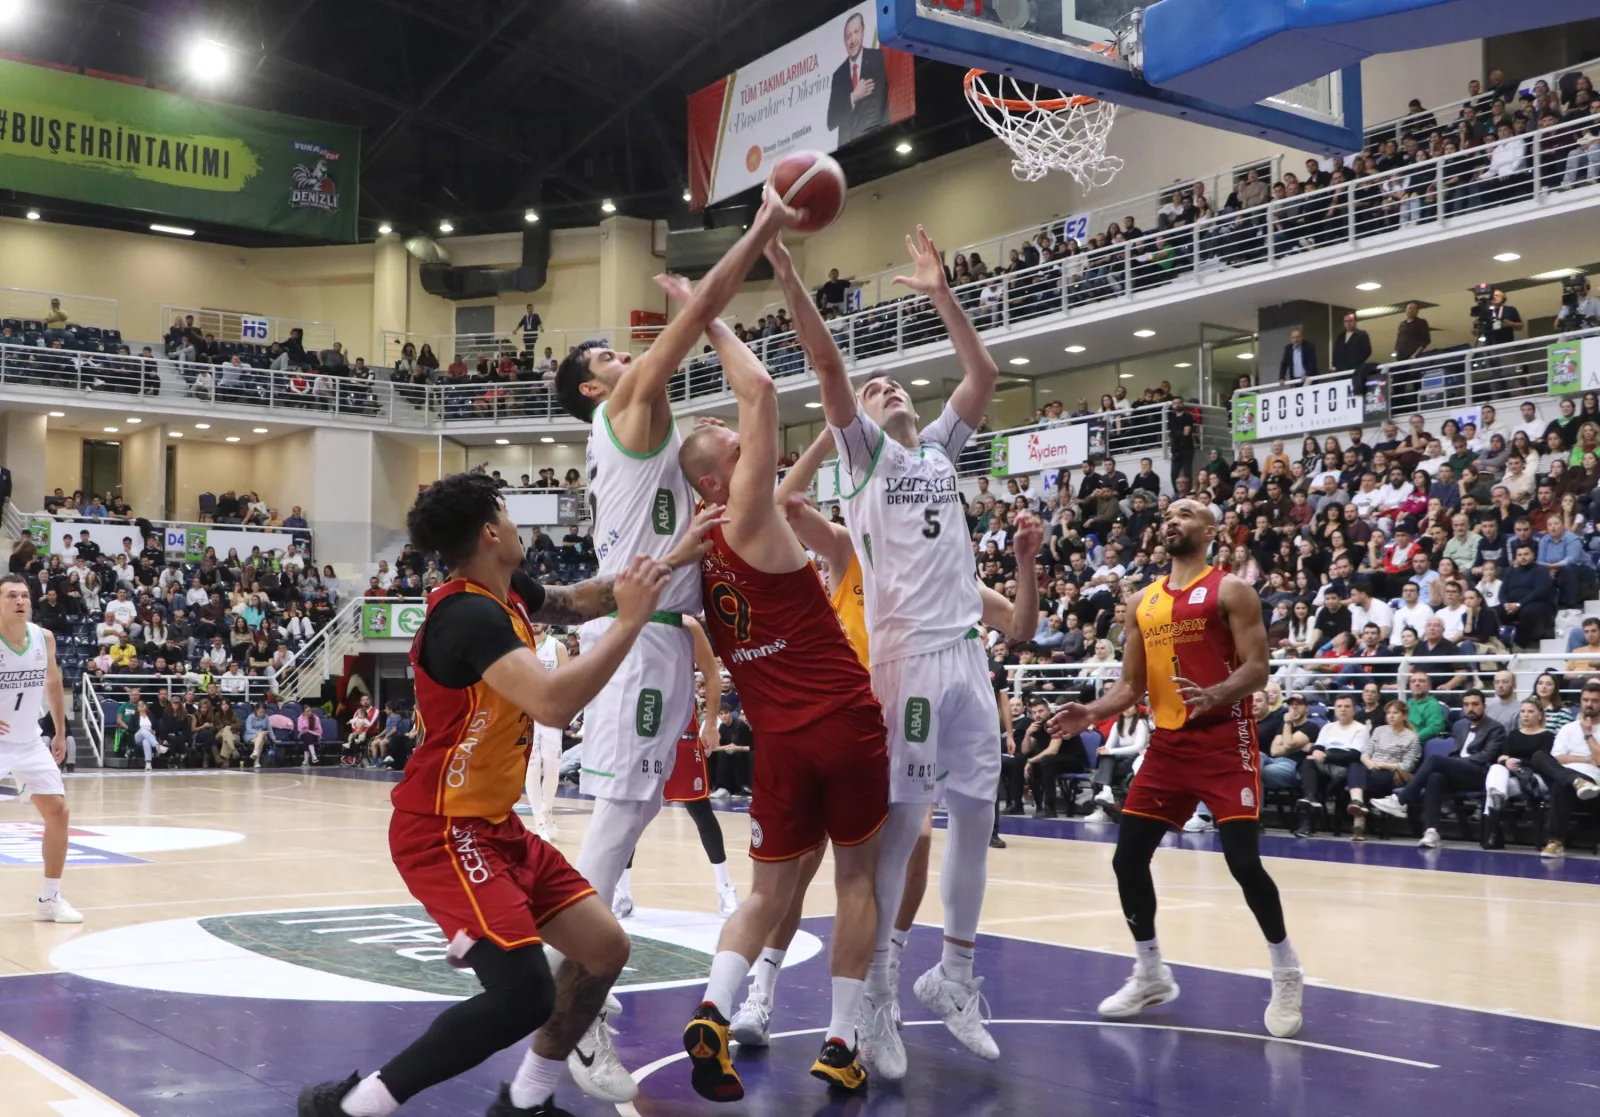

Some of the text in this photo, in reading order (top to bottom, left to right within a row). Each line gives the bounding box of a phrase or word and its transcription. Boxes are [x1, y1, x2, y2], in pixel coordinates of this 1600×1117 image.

[741, 54, 819, 106] TÜM TAKIMLARIMIZA
[0, 108, 230, 180] #BUŞEHRİNTAKIMI
[1067, 217, 1087, 243] E2
[847, 289, 861, 312] E1
[243, 320, 268, 339] H5
[1261, 384, 1357, 422] BOSTON
[1028, 444, 1068, 462] Aydem
[658, 494, 669, 530] ABALI
[922, 509, 941, 539] 5
[168, 533, 185, 546] D4
[711, 581, 752, 643] 9
[14, 692, 24, 711] 1
[642, 694, 655, 732] ABALI
[910, 702, 923, 738] ABALI
